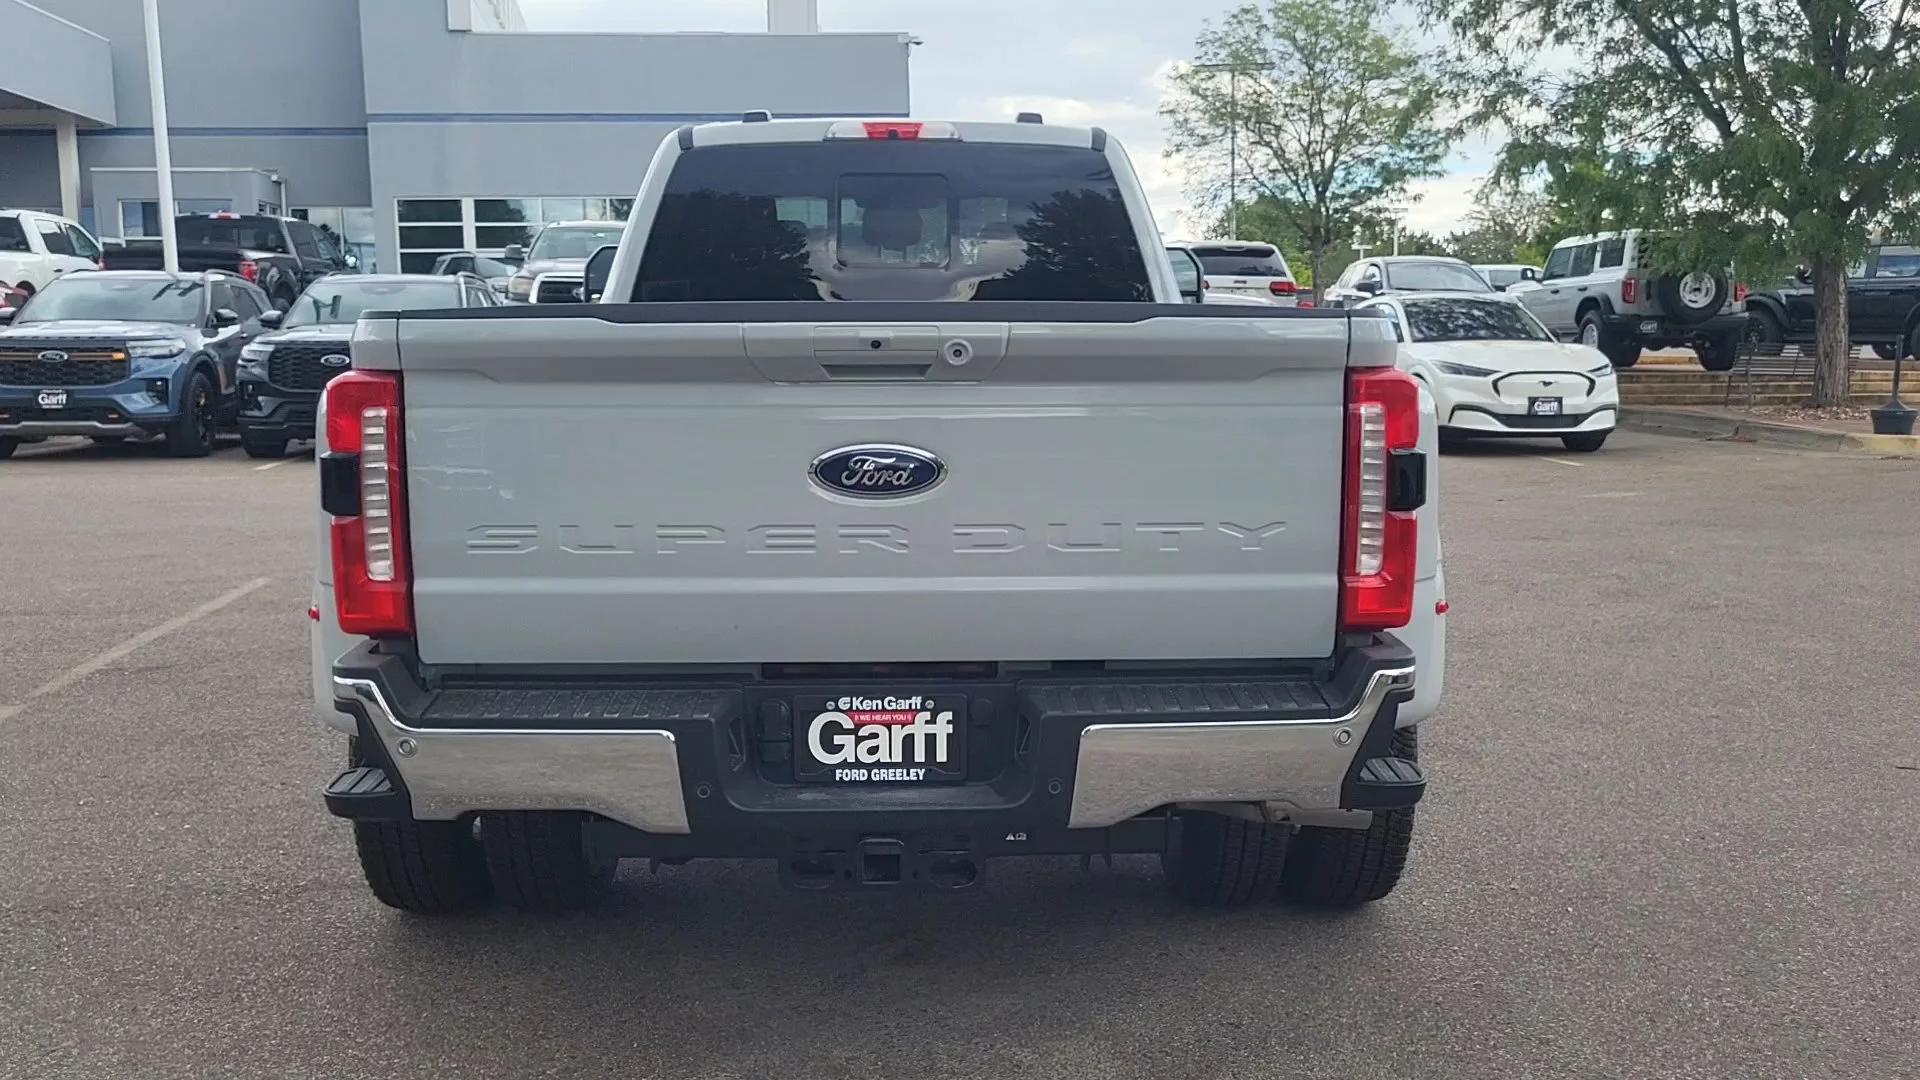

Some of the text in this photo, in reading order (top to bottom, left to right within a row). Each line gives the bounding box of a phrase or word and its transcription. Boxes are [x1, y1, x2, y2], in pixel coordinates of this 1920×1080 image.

[38, 393, 67, 405] Garff
[841, 455, 915, 486] Ford
[467, 521, 1286, 554] SUPER DUTY
[852, 696, 922, 711] Ken Garff
[808, 711, 953, 765] Garff
[835, 768, 926, 781] FORD GREELEY
